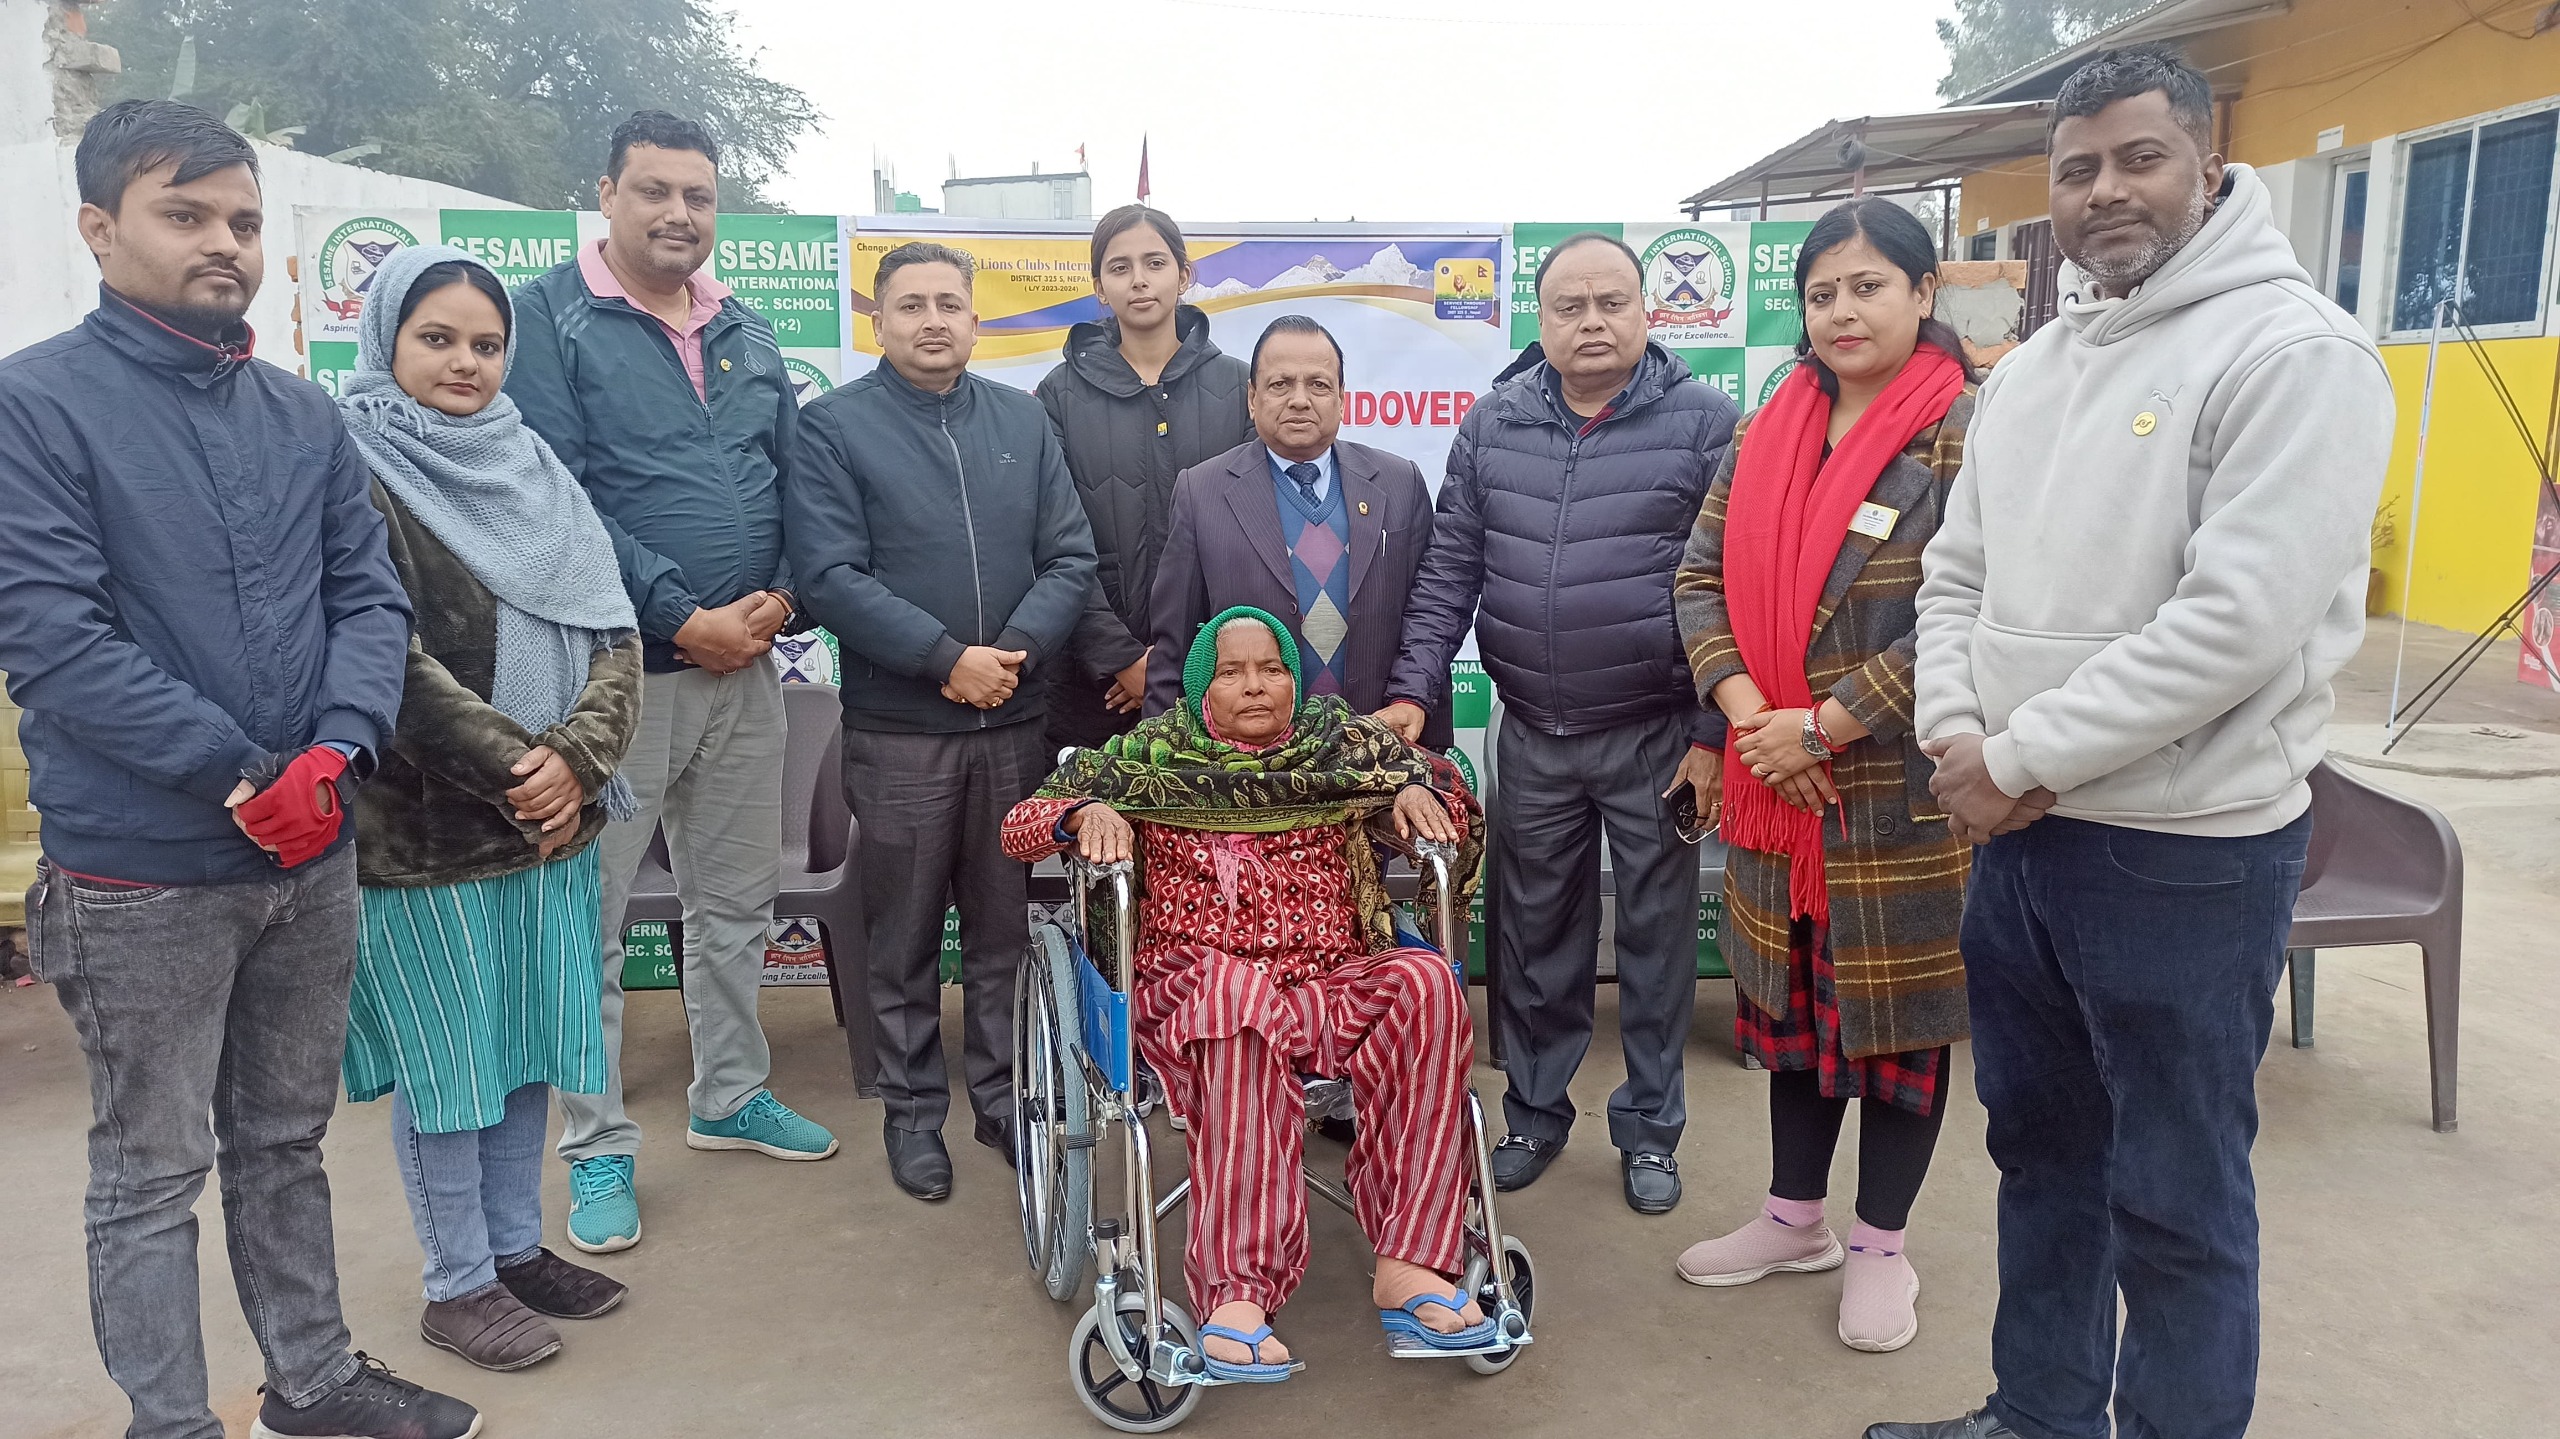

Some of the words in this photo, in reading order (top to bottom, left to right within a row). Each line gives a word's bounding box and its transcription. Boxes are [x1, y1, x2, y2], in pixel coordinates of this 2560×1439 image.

[323, 244, 336, 287] SESAME
[332, 220, 412, 247] INTERNATIONAL
[856, 242, 888, 253] Change
[719, 239, 838, 271] SESAME
[980, 257, 1013, 270] Lions
[1016, 258, 1051, 271] Clubs
[1650, 232, 1723, 257] INTERNATIONAL
[1720, 255, 1732, 297] SCHOOL
[773, 298, 834, 311] SCHOOL
[1512, 300, 1540, 314] SEC
[773, 317, 802, 334] (+2)
[1669, 332, 1683, 340] For
[784, 361, 823, 386] ATIONAL
[626, 944, 650, 957] EC.
[654, 963, 677, 980] (+2
[780, 972, 796, 980] For
